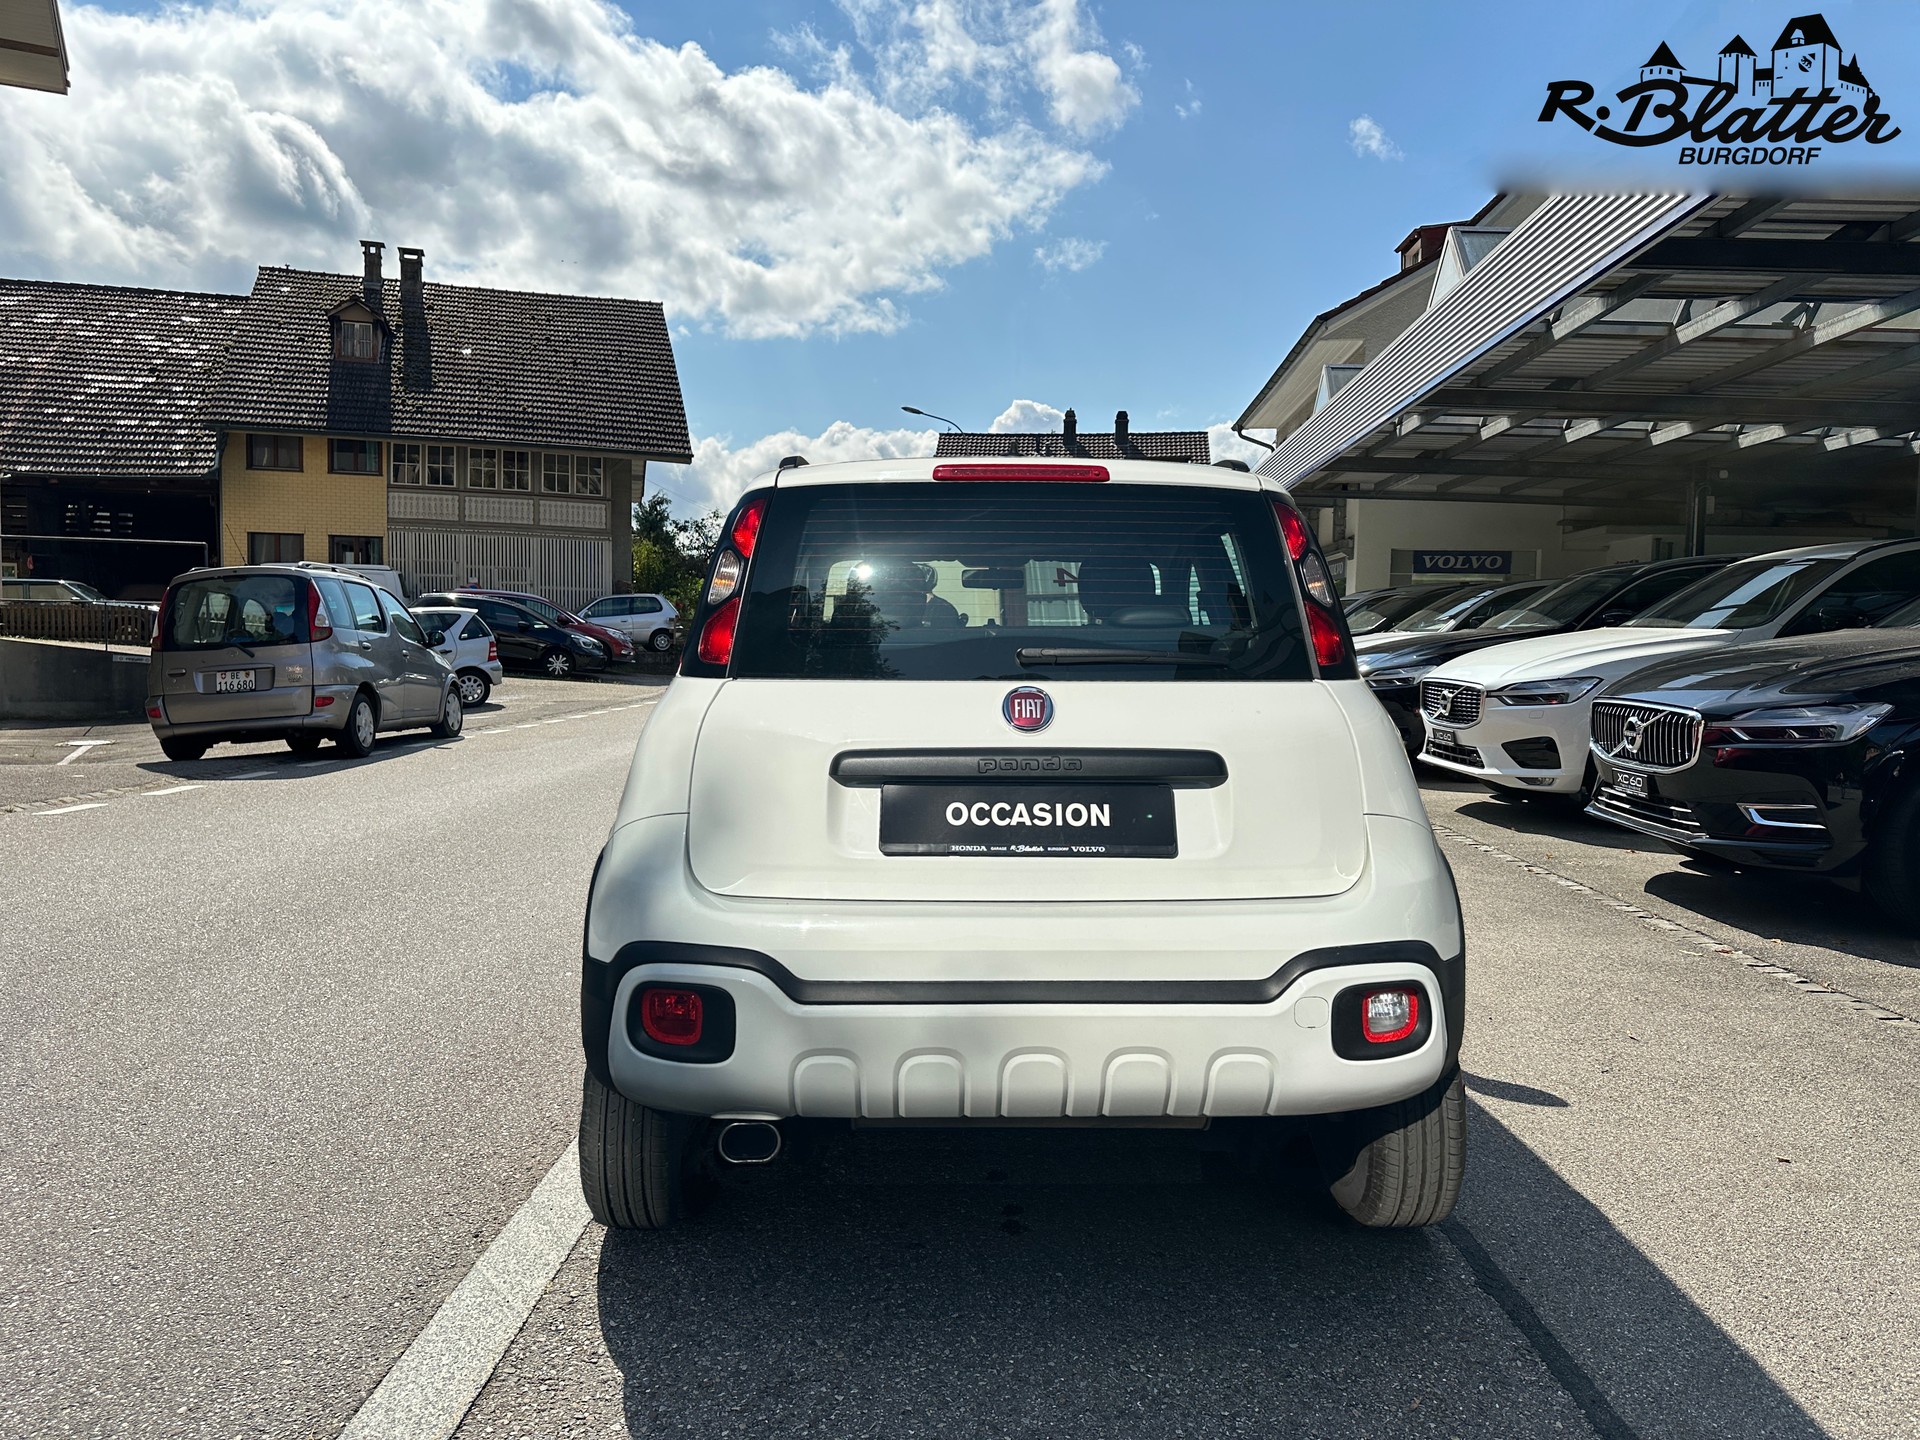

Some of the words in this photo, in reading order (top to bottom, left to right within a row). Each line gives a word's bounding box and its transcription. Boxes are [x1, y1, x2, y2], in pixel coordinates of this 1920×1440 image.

[1422, 555, 1503, 569] VOLVO
[230, 671, 241, 680] BE
[1014, 698, 1043, 719] FIAT
[977, 756, 1083, 774] panda
[945, 802, 1111, 827] OCCASION
[1070, 845, 1106, 853] VOLVO
